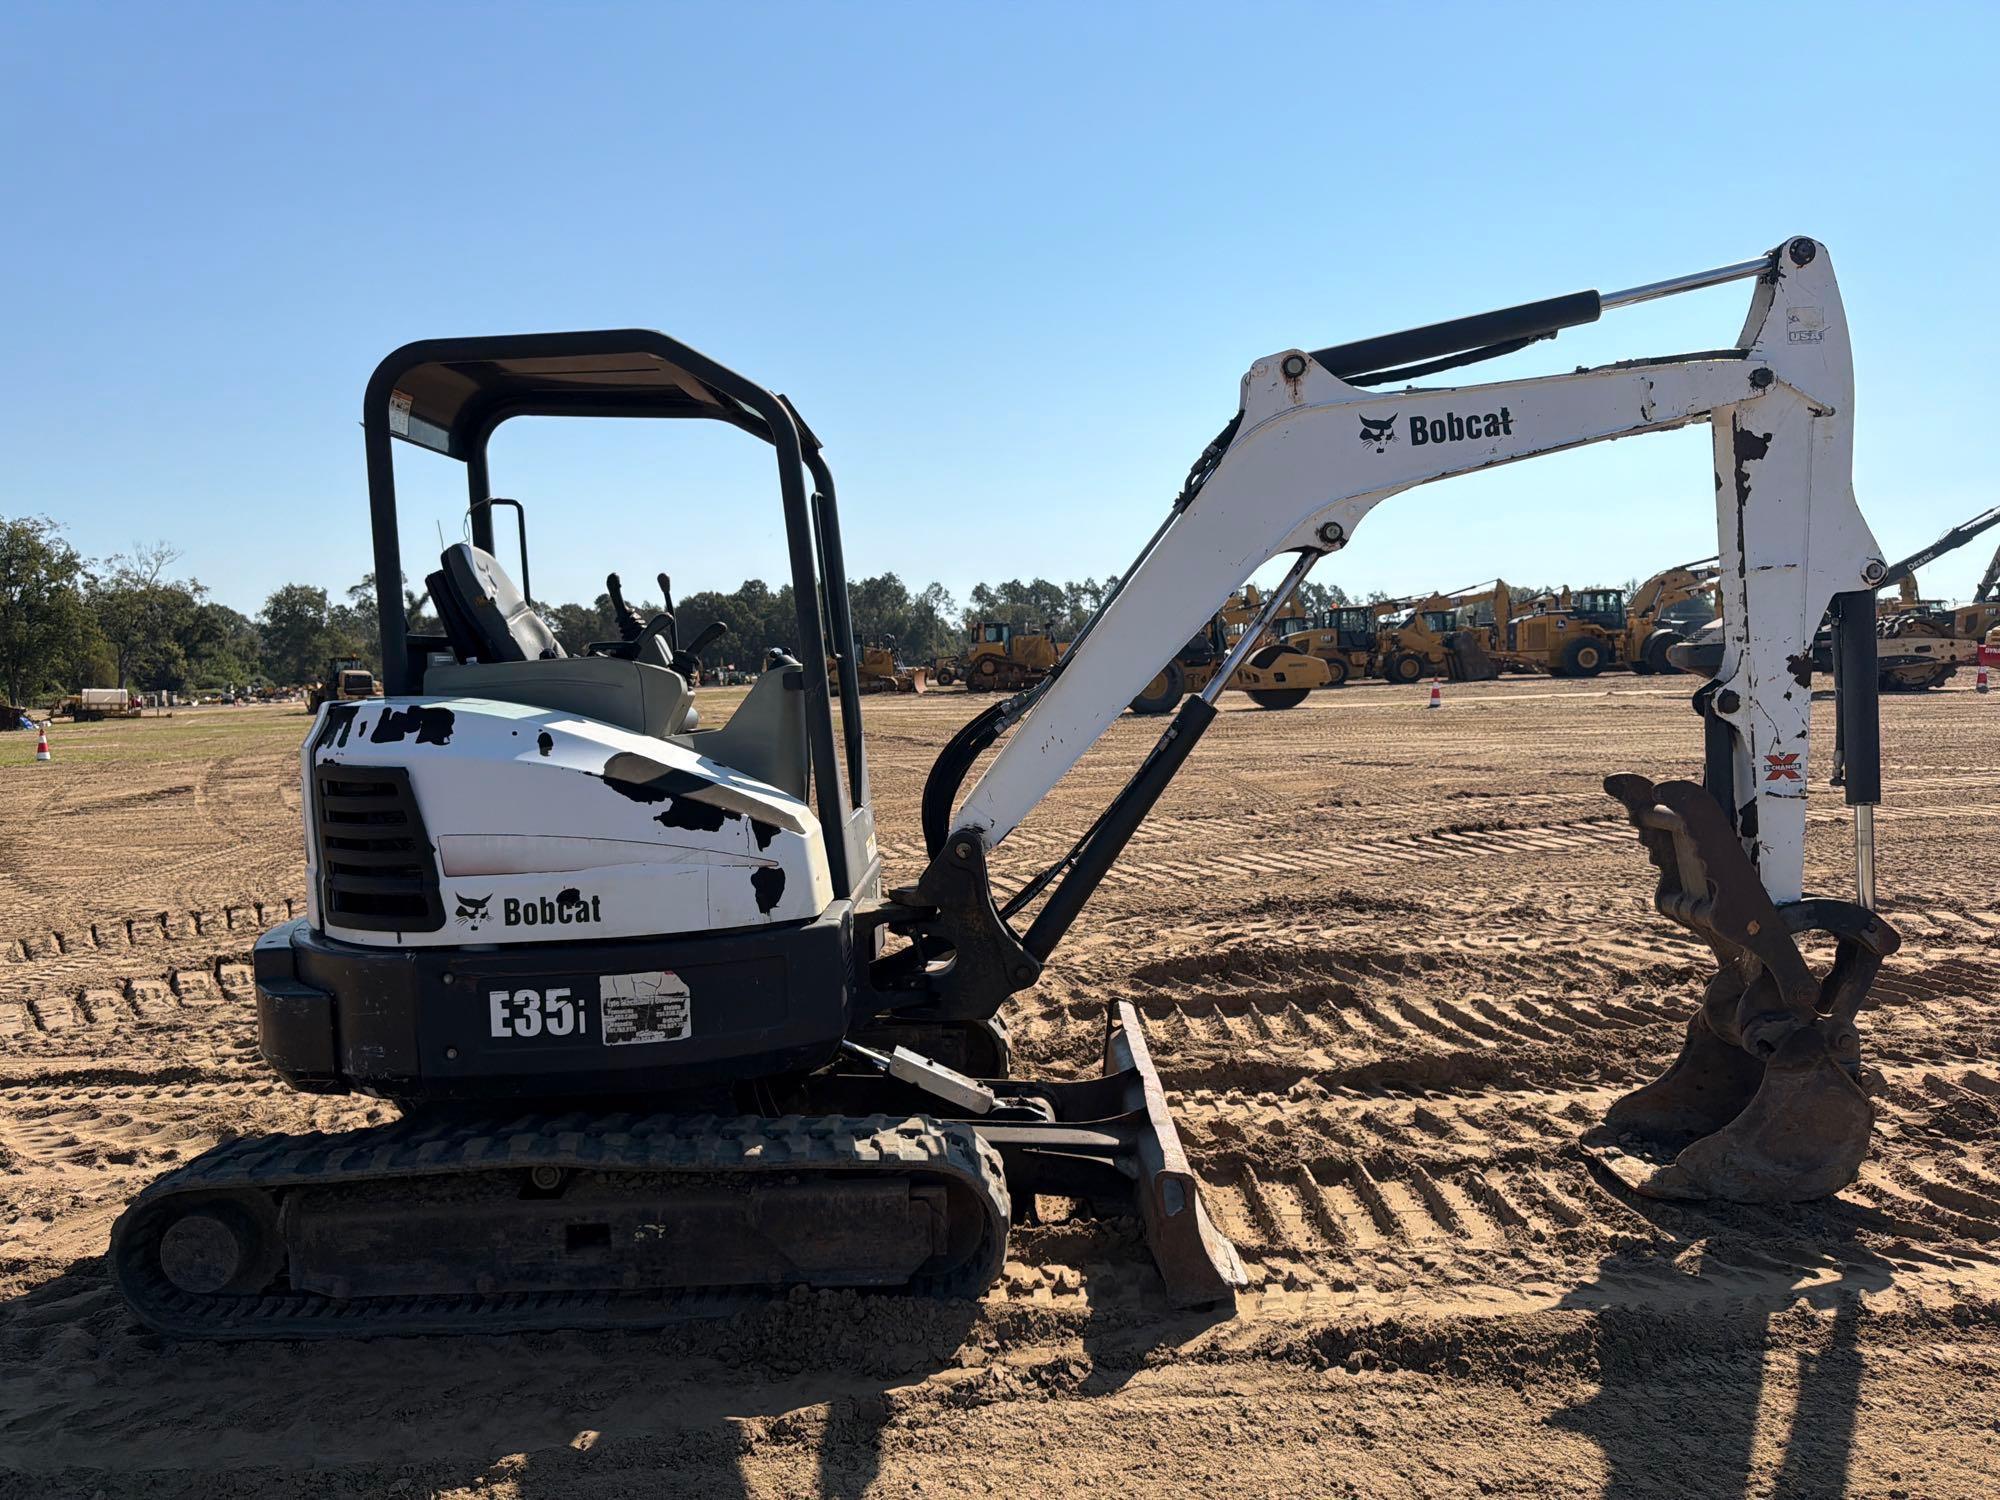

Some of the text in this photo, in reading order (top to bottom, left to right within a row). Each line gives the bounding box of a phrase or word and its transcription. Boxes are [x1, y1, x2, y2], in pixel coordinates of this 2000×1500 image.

[1790, 332, 1821, 341] USA
[1410, 407, 1512, 446] Bobcat
[1907, 552, 1936, 571] DEERE
[1985, 608, 1996, 616] CAT
[504, 895, 601, 927] Bobcat
[489, 988, 586, 1037] E35i
